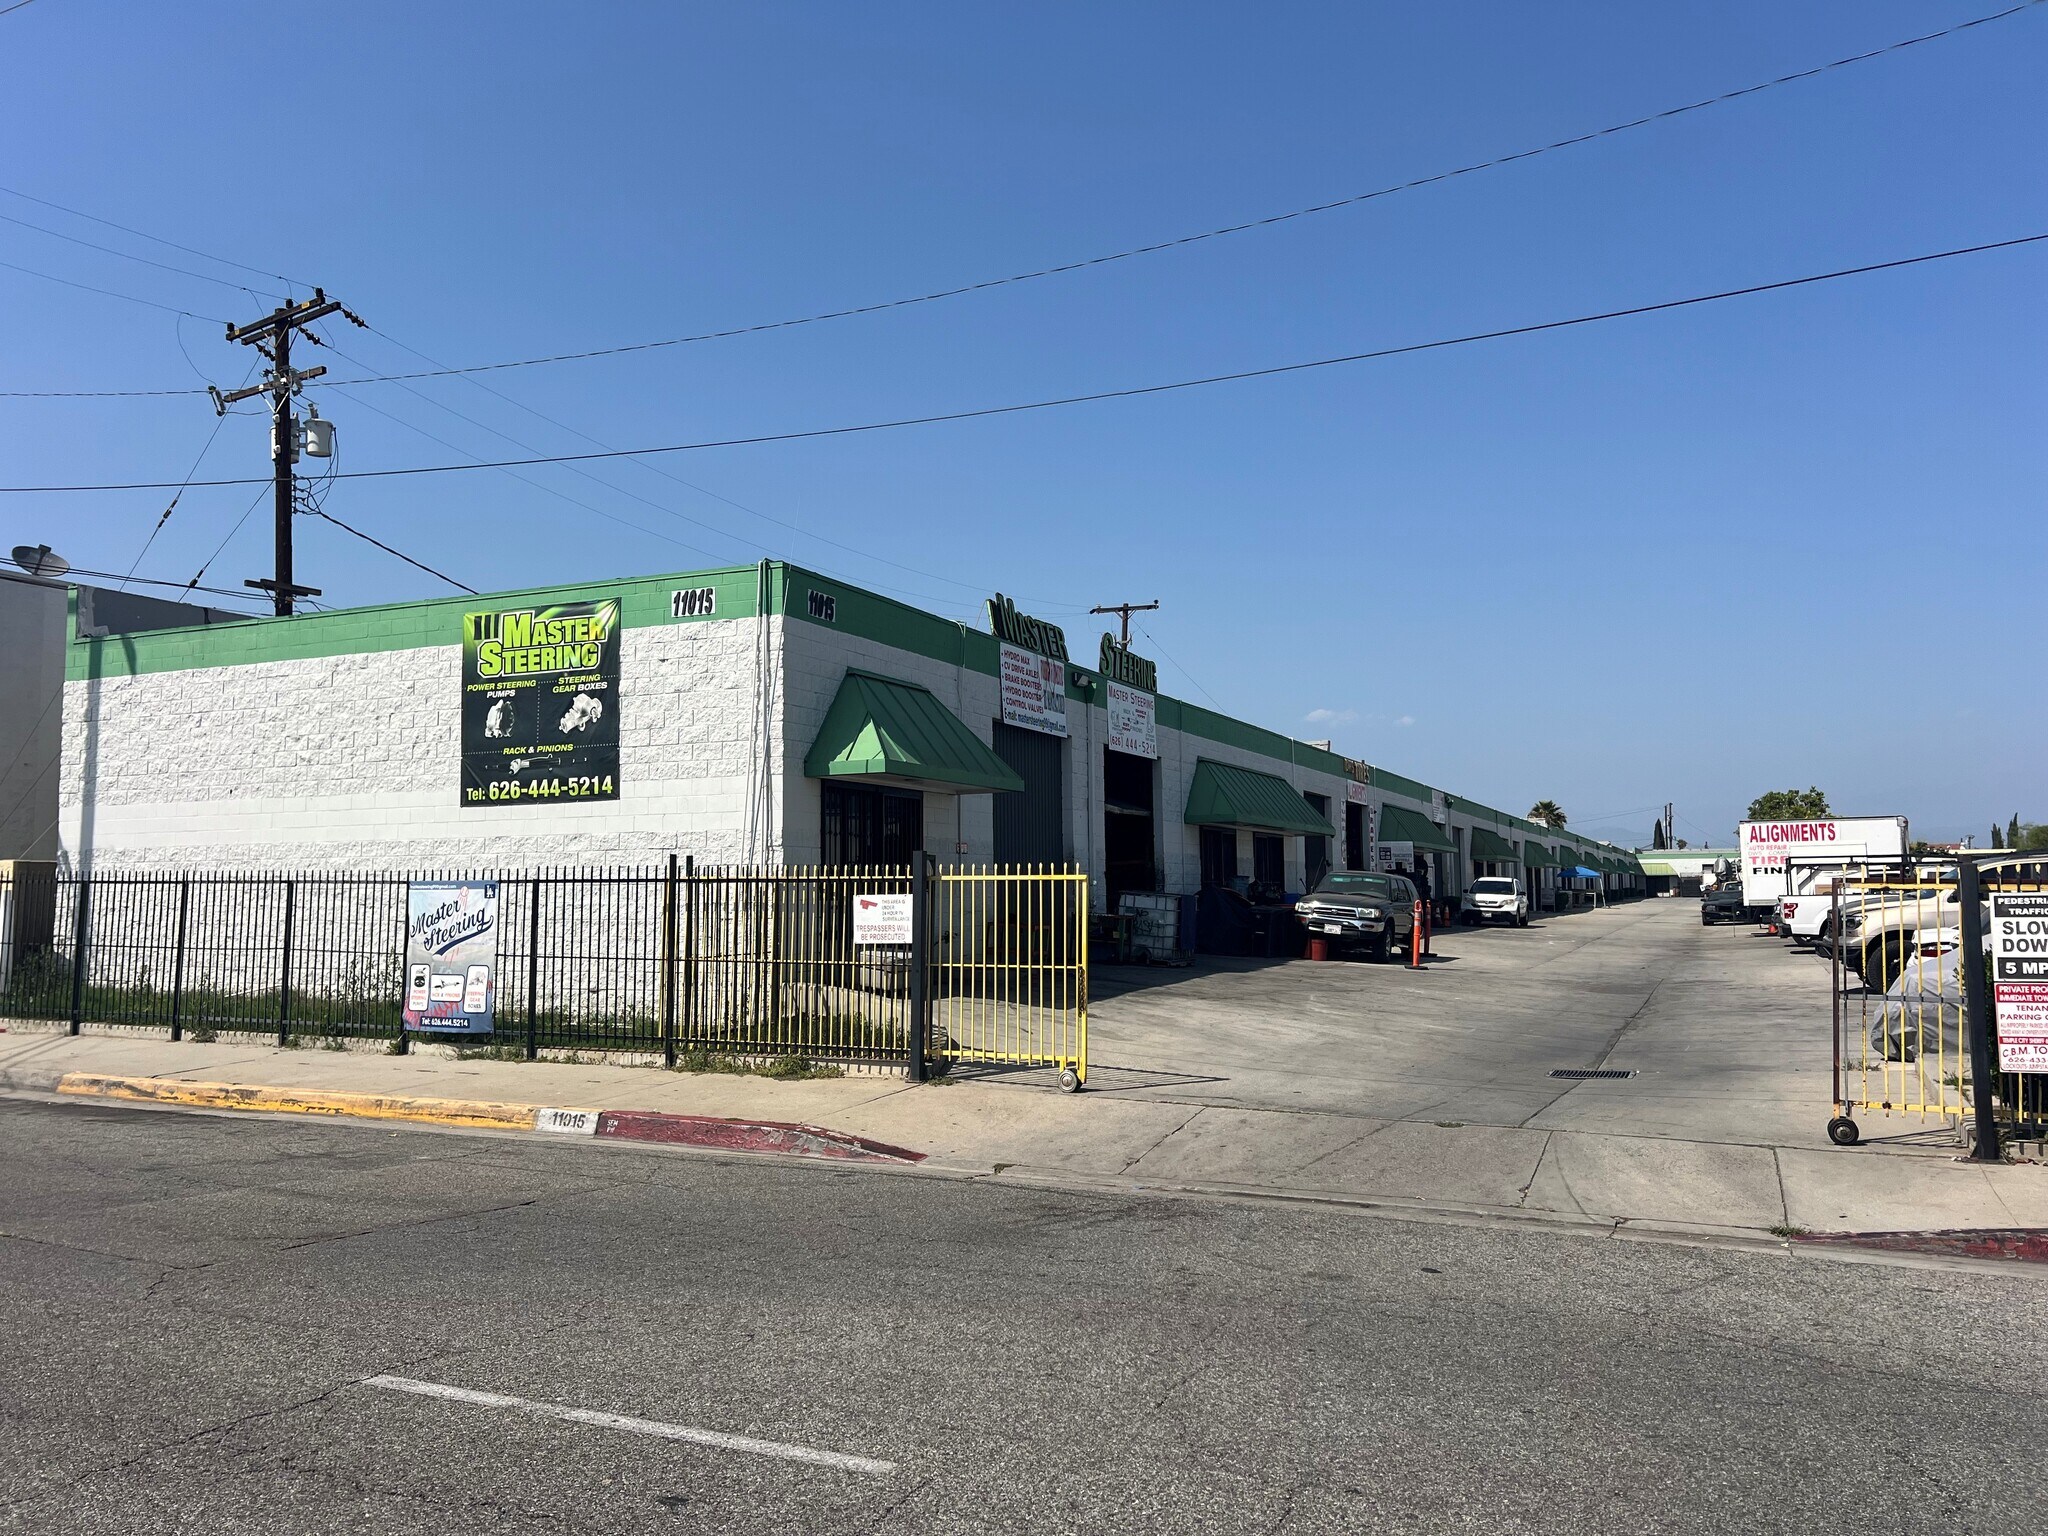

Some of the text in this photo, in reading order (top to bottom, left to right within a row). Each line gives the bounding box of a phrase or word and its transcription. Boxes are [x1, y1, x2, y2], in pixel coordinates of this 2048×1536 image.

[673, 588, 714, 616] 11015
[808, 590, 834, 621] 11015
[502, 611, 608, 650] MASTER
[994, 592, 1069, 662] MASTER
[478, 640, 600, 678] STEERING
[1004, 650, 1030, 665] HYDRO MAX
[1099, 632, 1157, 693] STEERING
[1011, 664, 1025, 675] DRIVE
[466, 680, 536, 692] POWER STEERING
[558, 674, 600, 684] STEERING
[1004, 673, 1020, 686] BRAKE
[486, 690, 516, 698] PUMPS
[552, 681, 608, 693] GEAR BOXES
[1005, 685, 1021, 698] HYDRO
[1006, 697, 1027, 710] CONTROL
[1108, 684, 1154, 710] MASTER STEERING
[1110, 734, 1124, 748] (626)
[503, 746, 526, 754] RACK
[537, 744, 574, 752] PINIONS
[466, 775, 612, 800] Tel: 626-444-5214
[1750, 822, 1836, 842] ALIGNMENTS
[410, 899, 461, 938] Master
[423, 907, 490, 951] Steering
[2006, 962, 2017, 974] 5
[431, 1018, 468, 1026] 626.444.5214
[2002, 1046, 2030, 1057] C.B.M.
[553, 1112, 586, 1128] 11015
